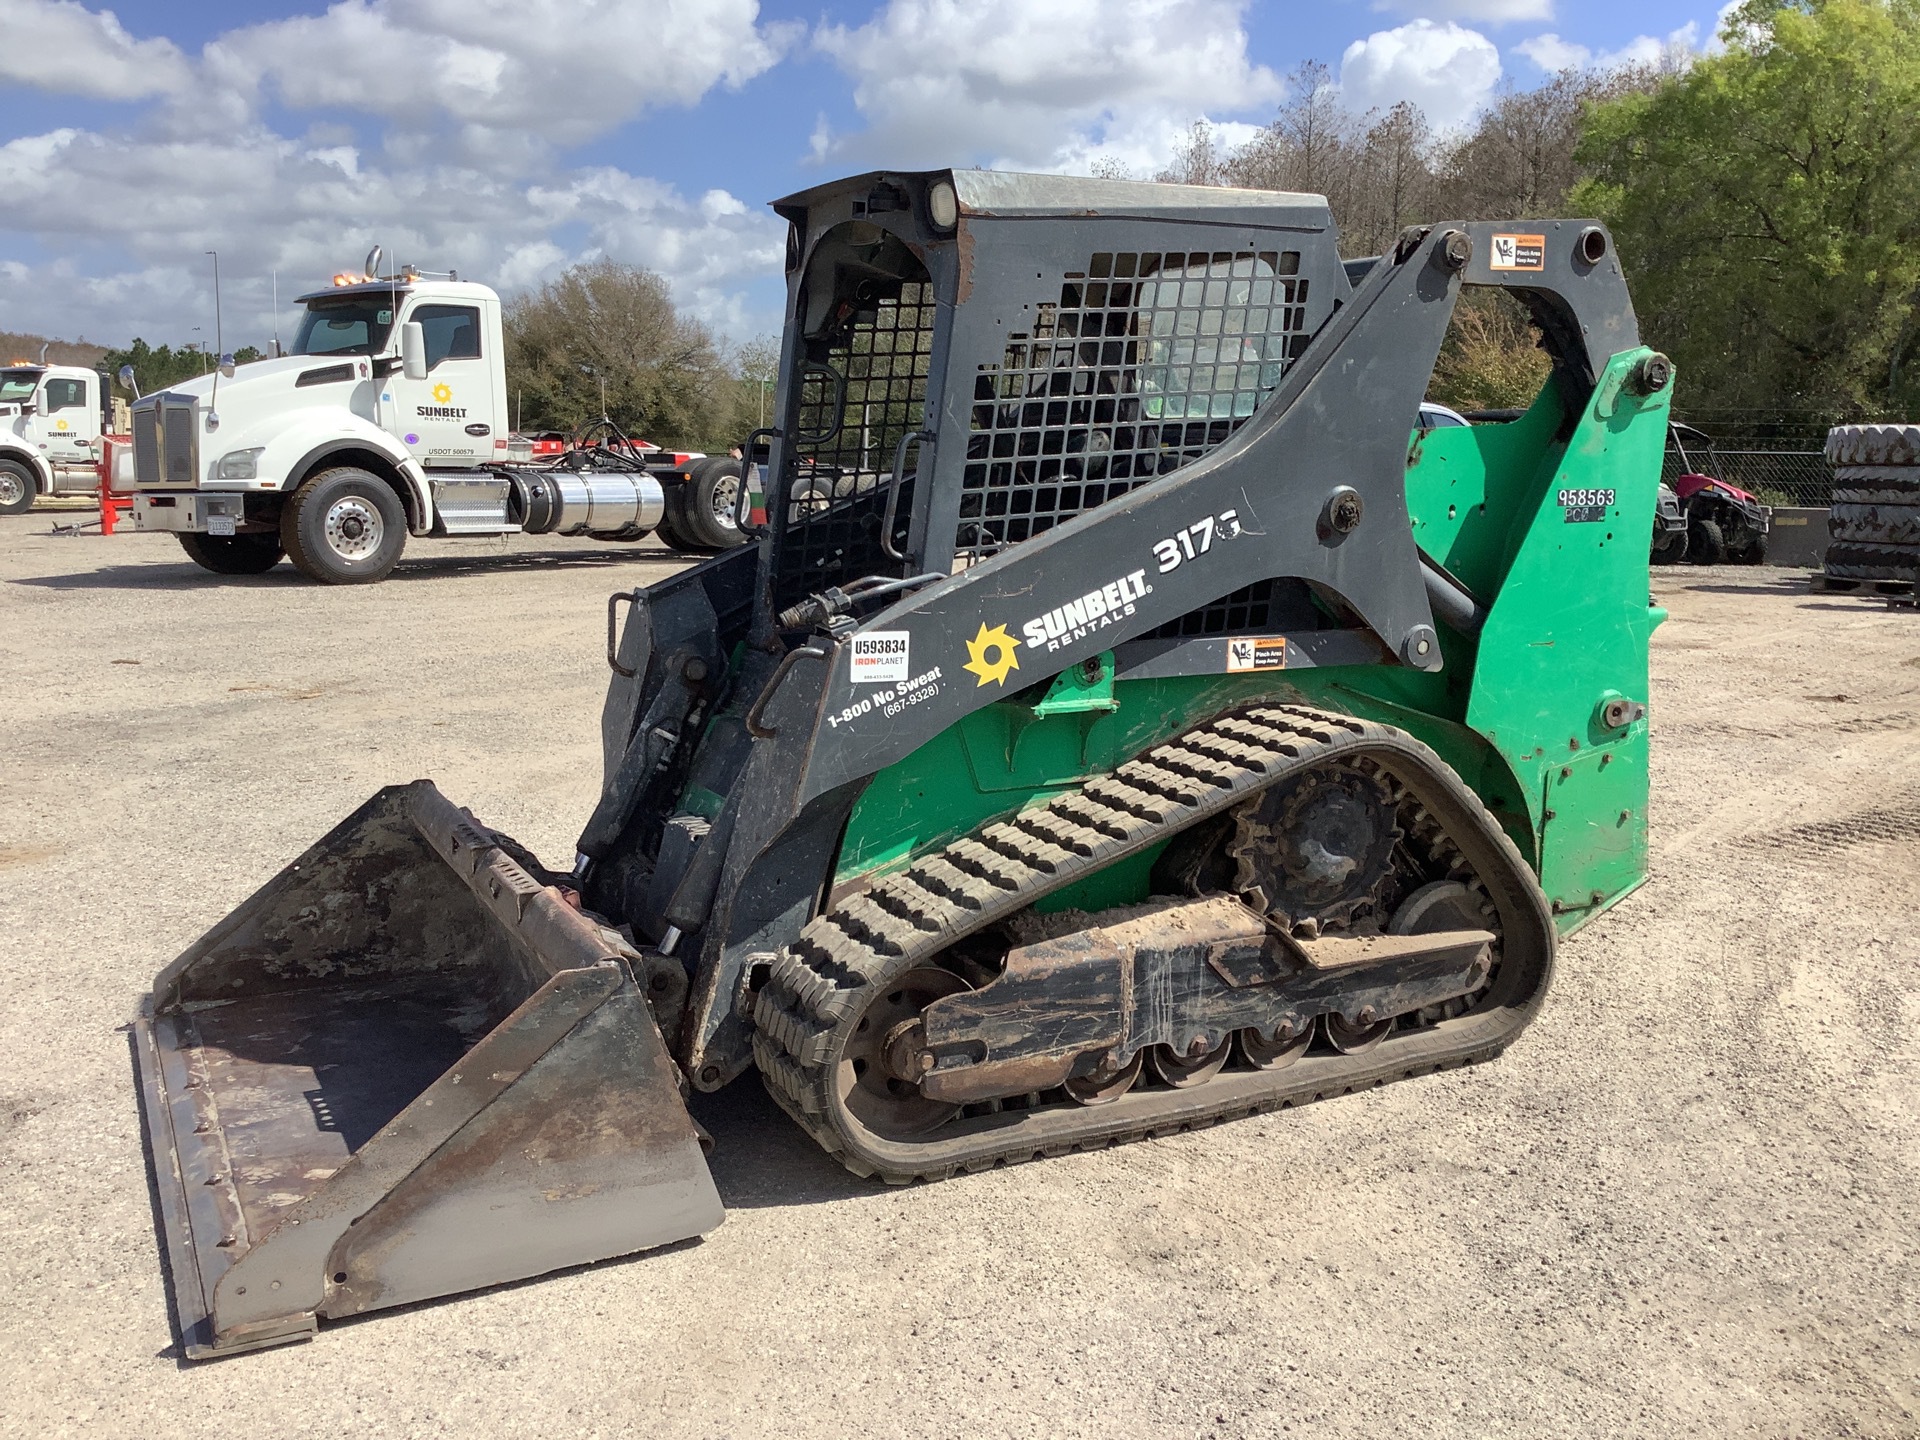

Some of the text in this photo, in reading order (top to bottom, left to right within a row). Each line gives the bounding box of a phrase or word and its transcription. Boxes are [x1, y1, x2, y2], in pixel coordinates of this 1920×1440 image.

[417, 406, 467, 418] SUNBELT
[1558, 488, 1615, 506] 958563
[1151, 508, 1241, 575] 317G
[1022, 568, 1147, 649] SUNBELT
[1046, 602, 1136, 652] RENTALS
[855, 639, 906, 655] U593834
[1255, 650, 1271, 658] Pinch
[854, 656, 904, 666] IRONPLANET
[827, 666, 942, 728] 1-800 No Sweat
[883, 682, 939, 719] (667-9328)
